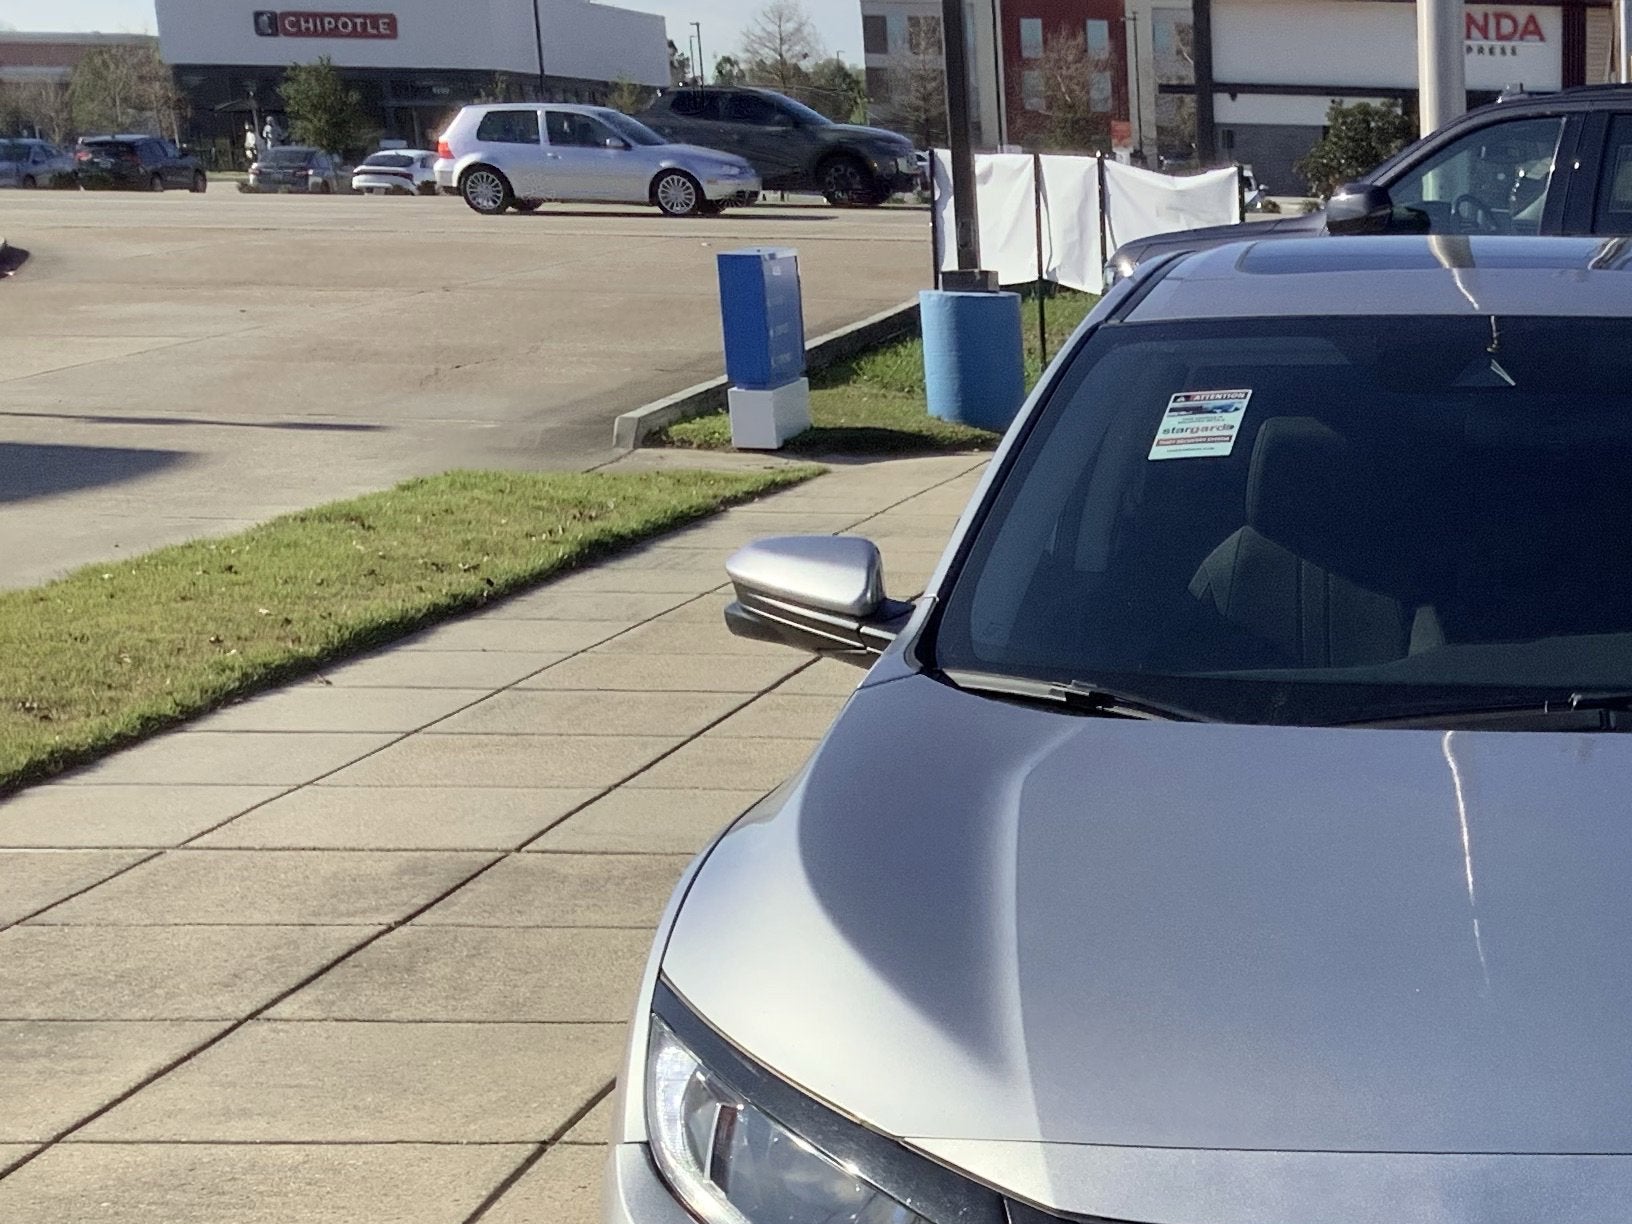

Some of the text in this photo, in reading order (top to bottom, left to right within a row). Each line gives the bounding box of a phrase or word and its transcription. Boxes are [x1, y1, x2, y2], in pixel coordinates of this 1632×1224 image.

[284, 16, 392, 34] CHIPOTLE
[1465, 11, 1546, 41] NDA
[1466, 45, 1517, 56] PRESS
[1194, 392, 1245, 401] ATTENTION
